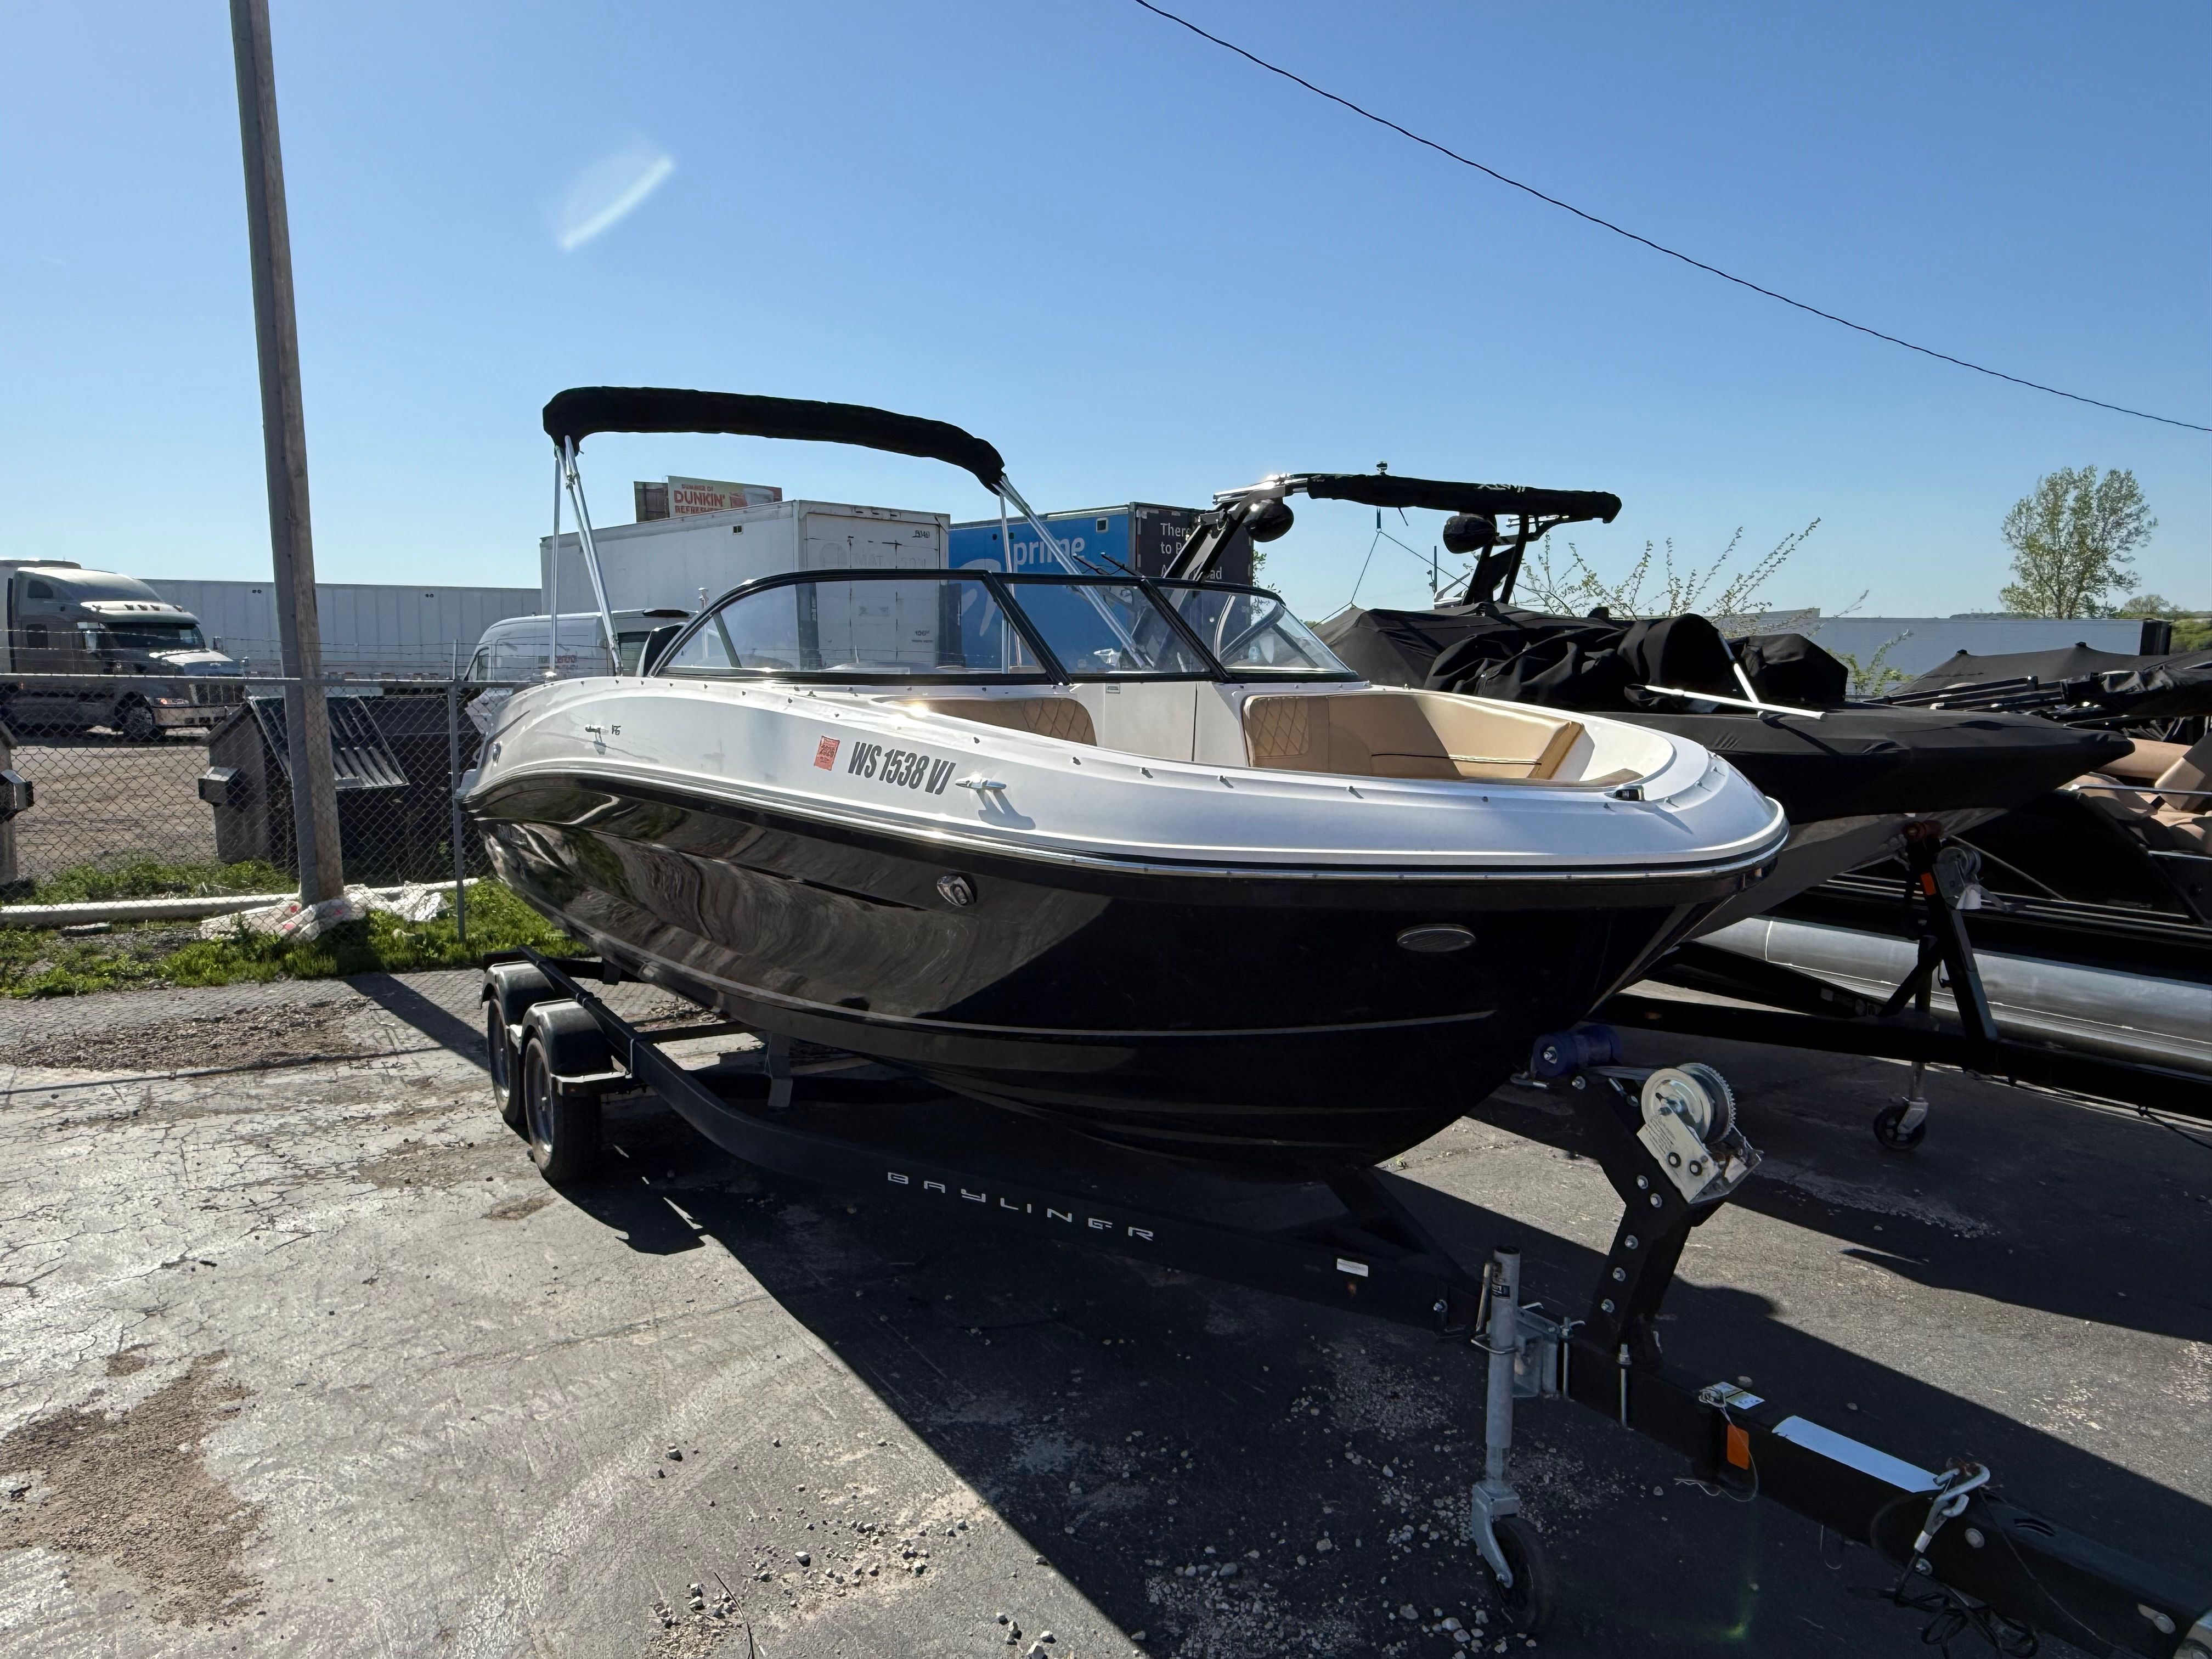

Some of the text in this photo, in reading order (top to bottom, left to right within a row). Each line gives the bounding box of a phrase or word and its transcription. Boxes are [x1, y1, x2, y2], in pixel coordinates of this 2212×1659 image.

[674, 490, 725, 507] DUNKIN'
[1160, 541, 1172, 554] to
[848, 741, 956, 795] WS 1538 VJ
[887, 1172, 1153, 1241] BAYLINER
